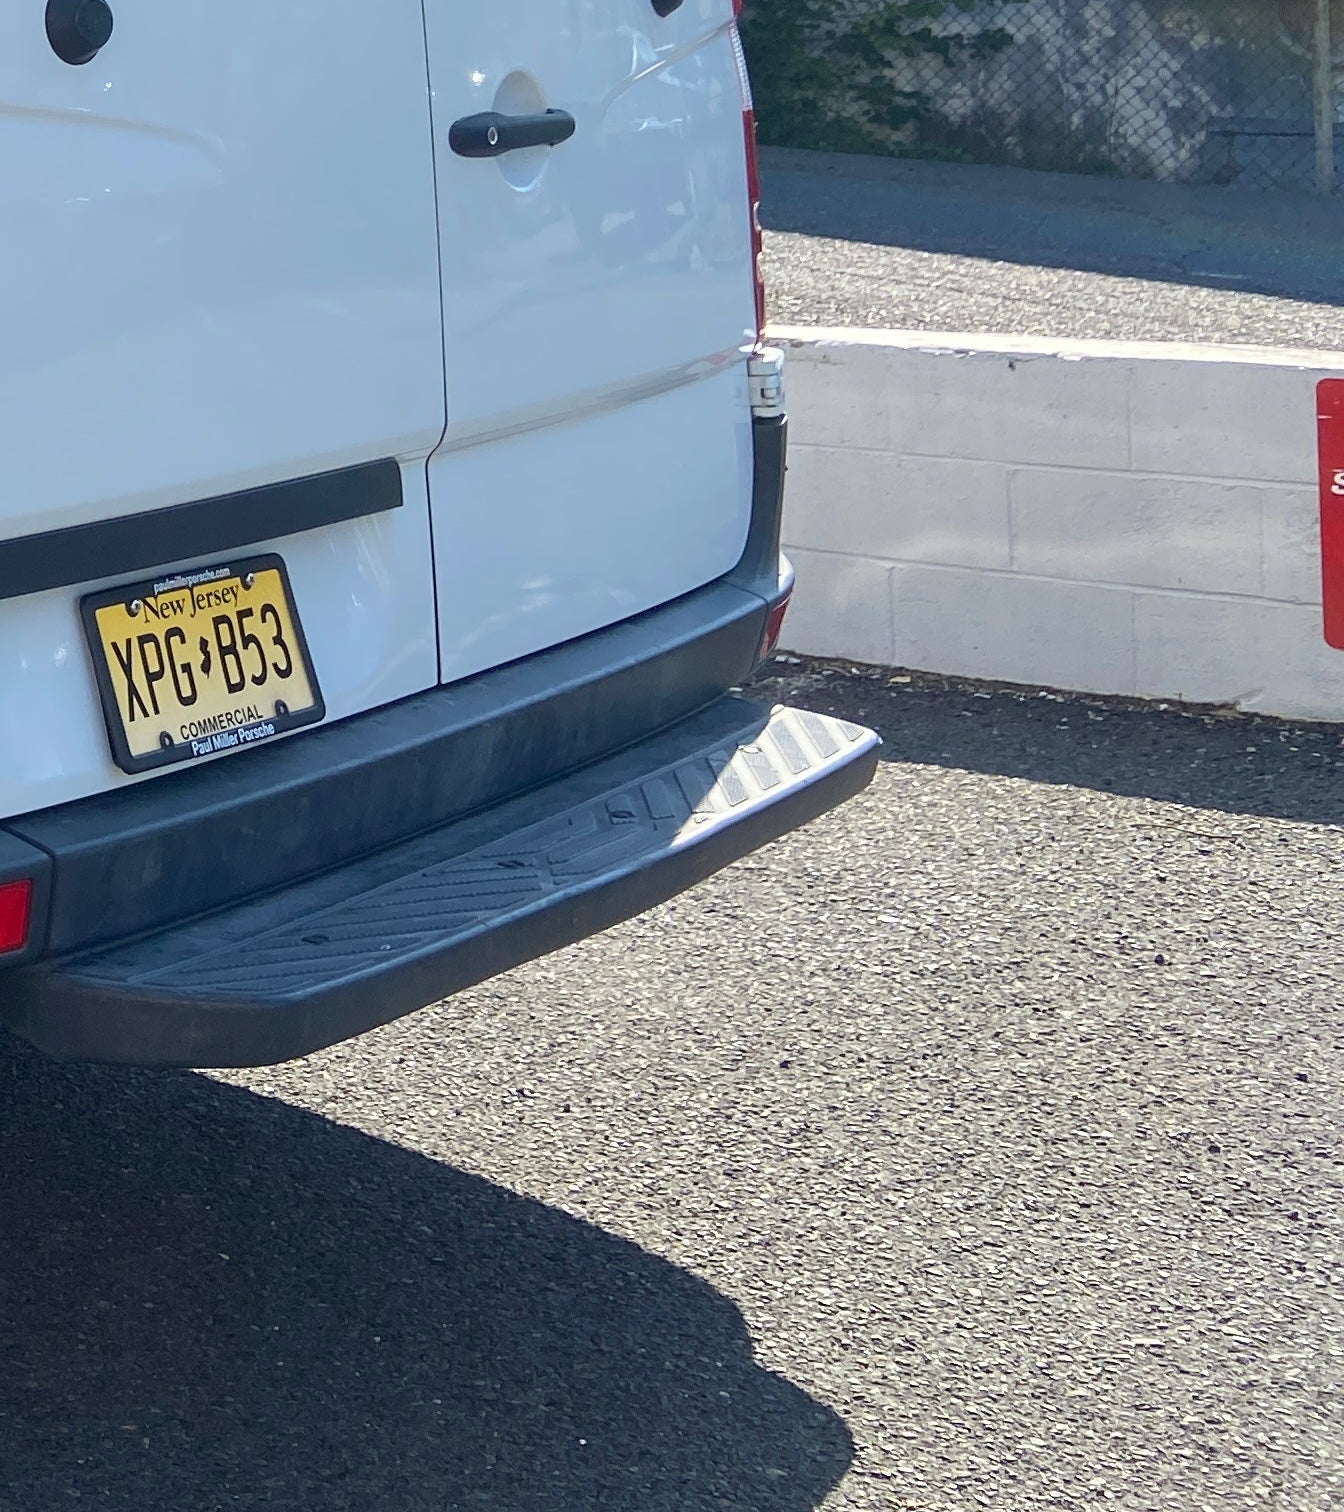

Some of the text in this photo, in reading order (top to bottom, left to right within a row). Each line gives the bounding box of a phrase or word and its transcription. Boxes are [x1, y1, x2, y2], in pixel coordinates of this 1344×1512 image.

[142, 584, 239, 624] New Jersey
[110, 603, 293, 723] XPG B53
[179, 704, 264, 741] COMMERCIAL
[191, 721, 275, 756] Paul Miller Porsche
